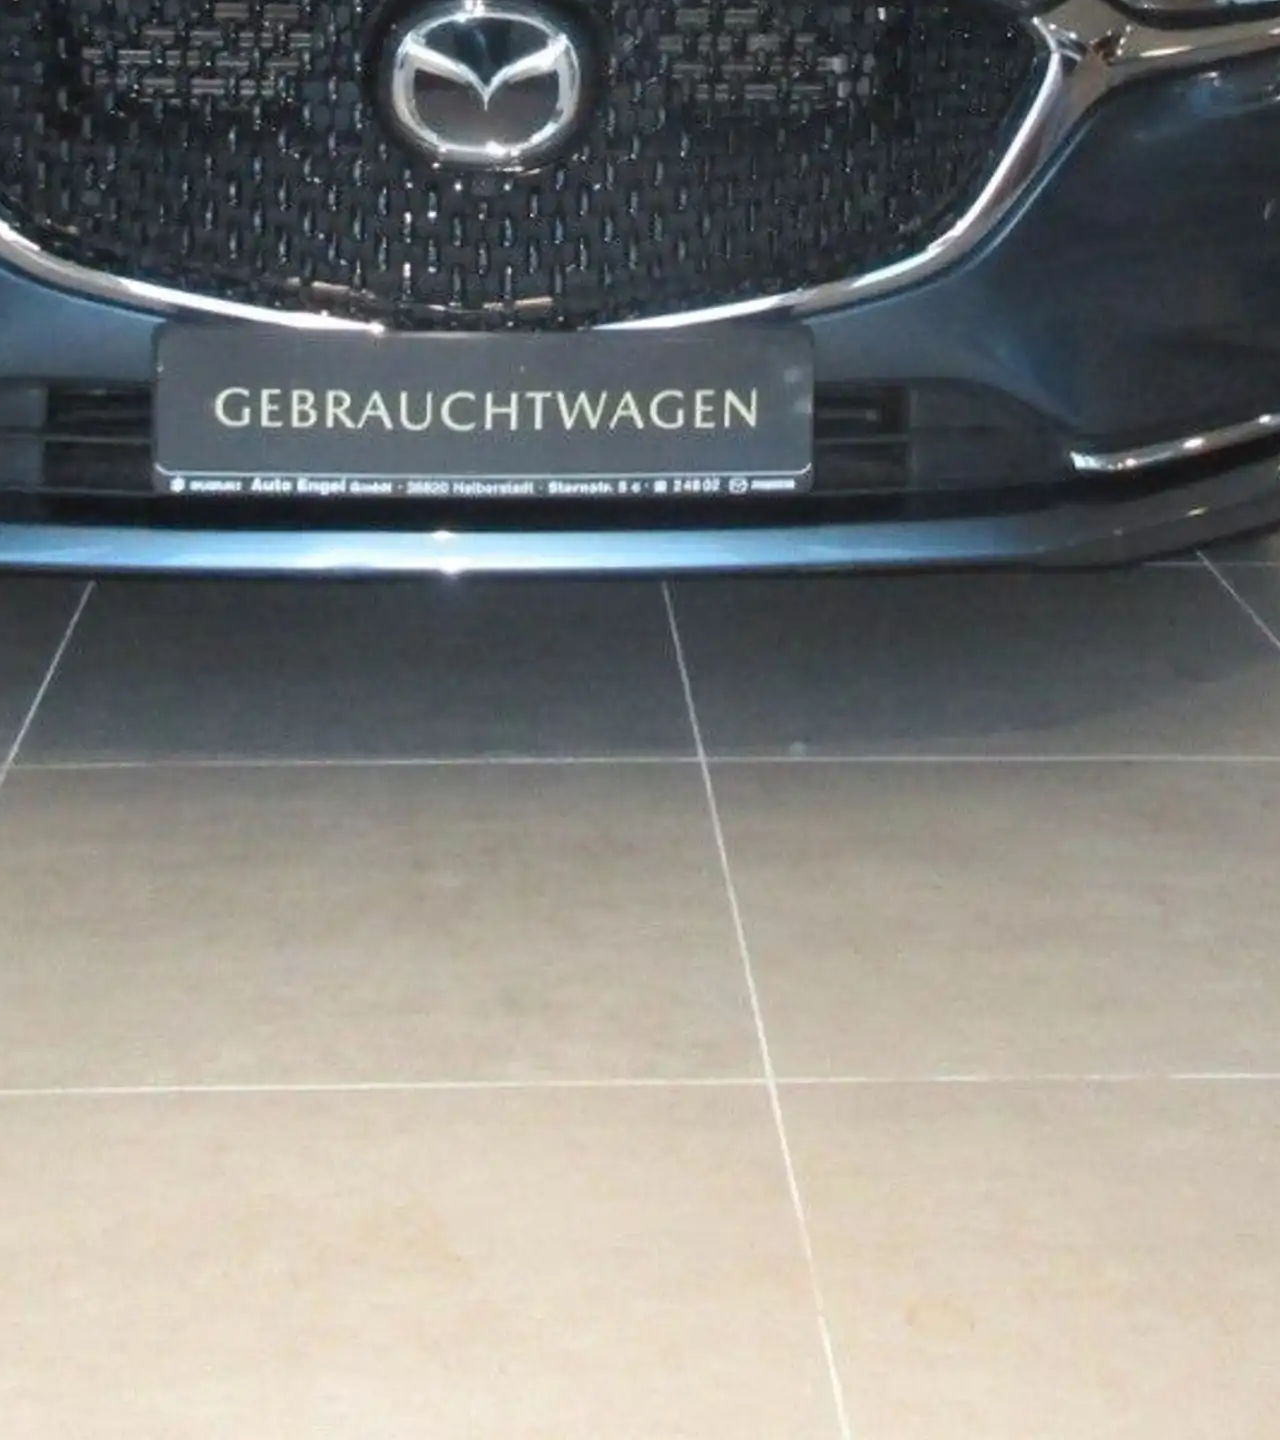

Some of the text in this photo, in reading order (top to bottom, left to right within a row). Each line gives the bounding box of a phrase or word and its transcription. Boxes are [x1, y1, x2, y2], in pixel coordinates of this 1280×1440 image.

[214, 385, 758, 431] GEBRAUCHTWAGEN
[250, 477, 292, 493] Auto
[297, 476, 346, 495] Engel
